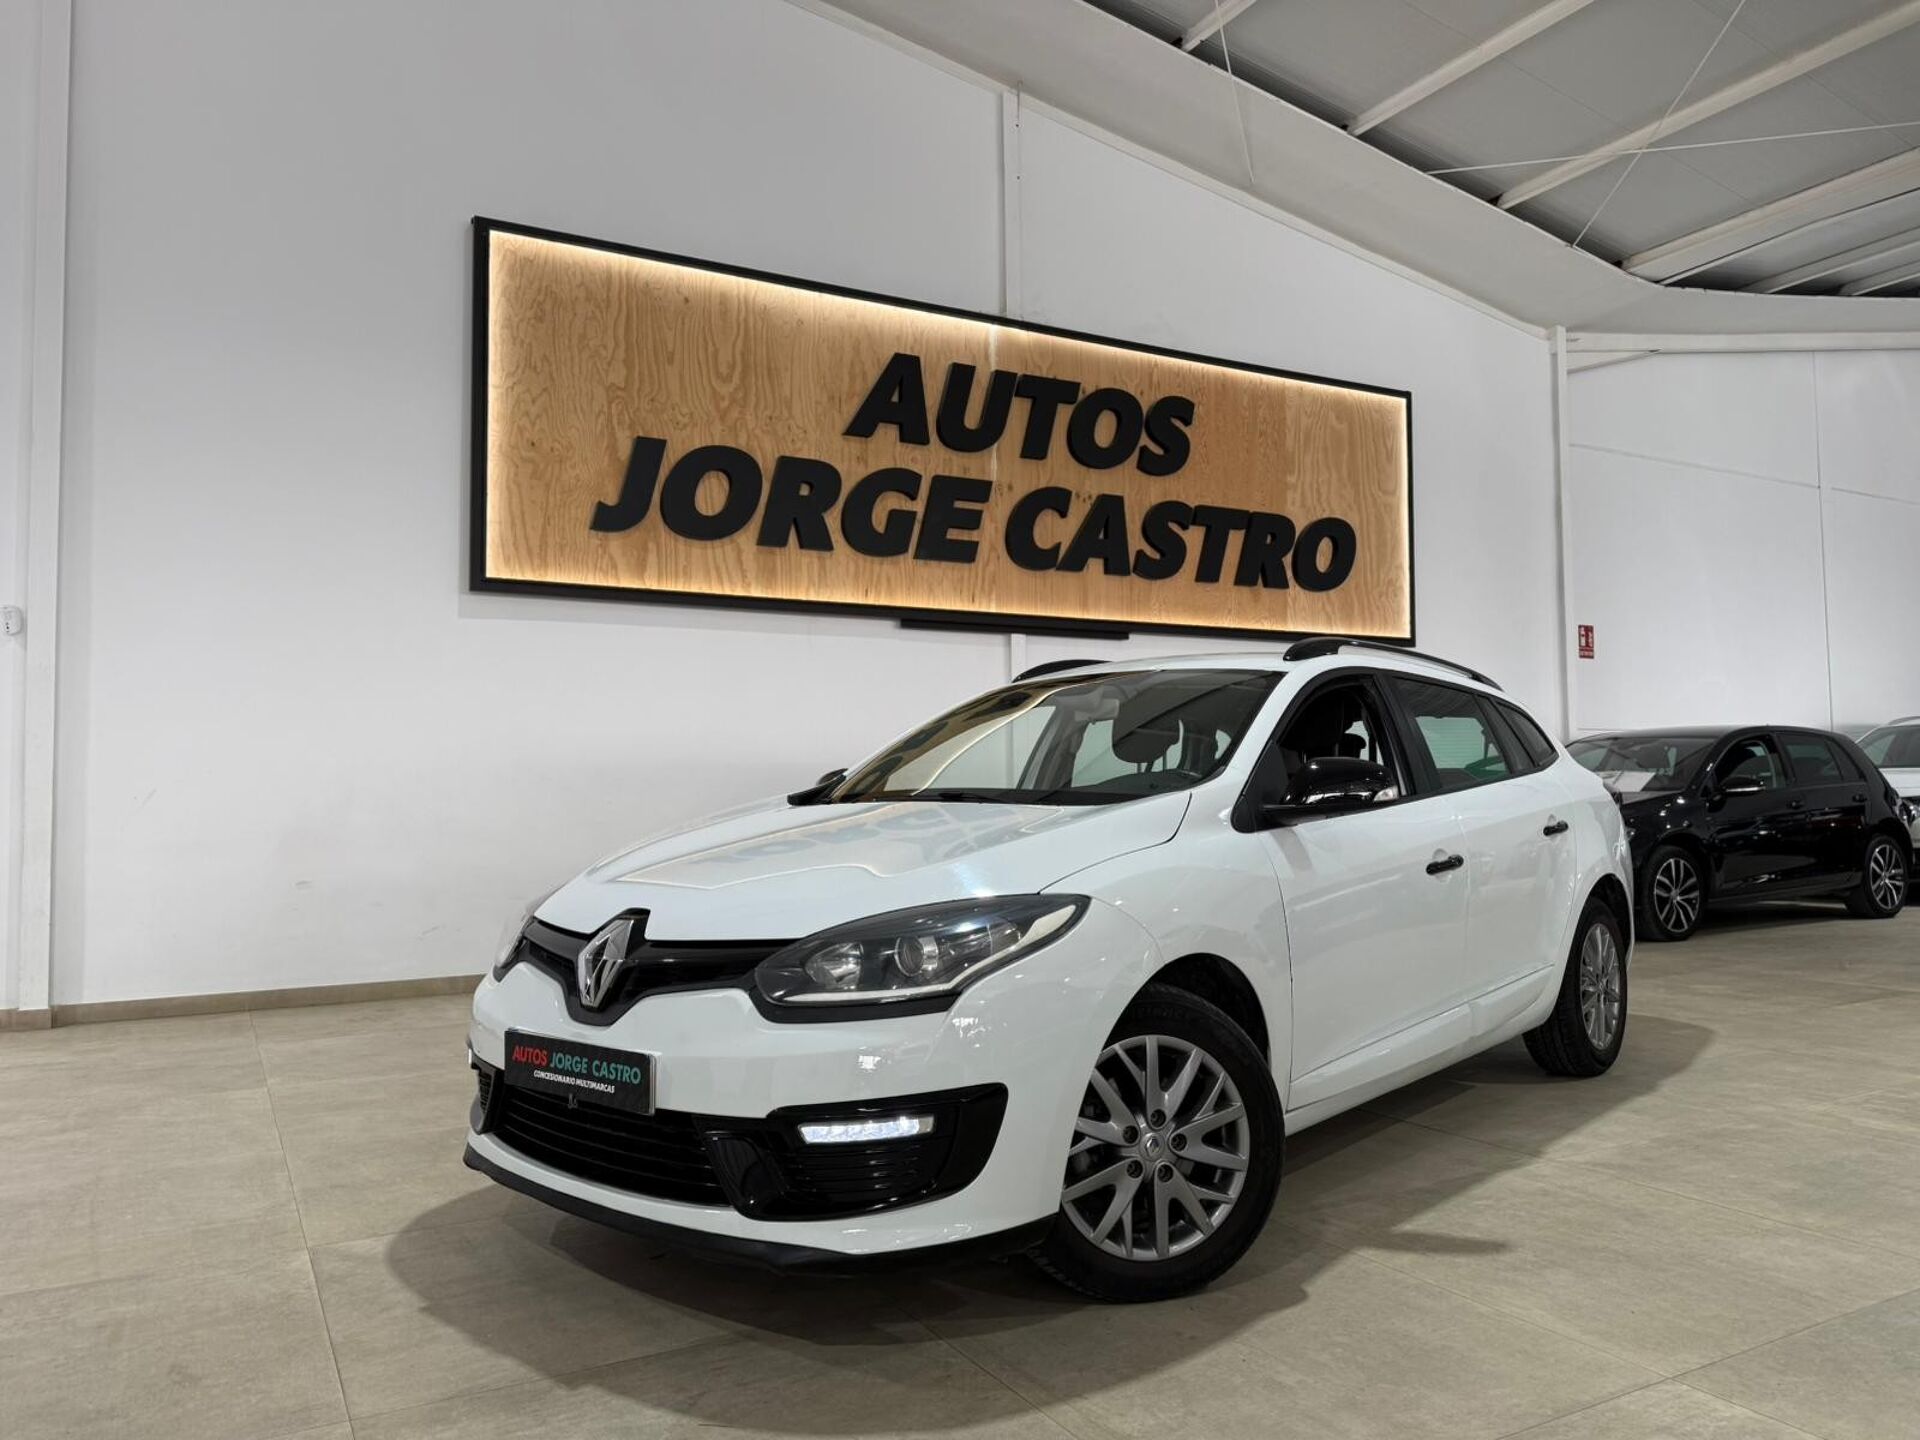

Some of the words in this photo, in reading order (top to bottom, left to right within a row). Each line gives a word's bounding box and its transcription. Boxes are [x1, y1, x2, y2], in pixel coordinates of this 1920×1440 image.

[843, 353, 1195, 477] AUTOS
[590, 436, 993, 564] JORGE
[1005, 486, 1356, 592] CASTRO
[512, 1045, 548, 1067] AUTOS
[551, 1052, 589, 1074] JORGE
[592, 1060, 642, 1085] CASTRO
[533, 1069, 576, 1085] CONCESIONARIO
[576, 1078, 615, 1094] MULTIMARCAS
